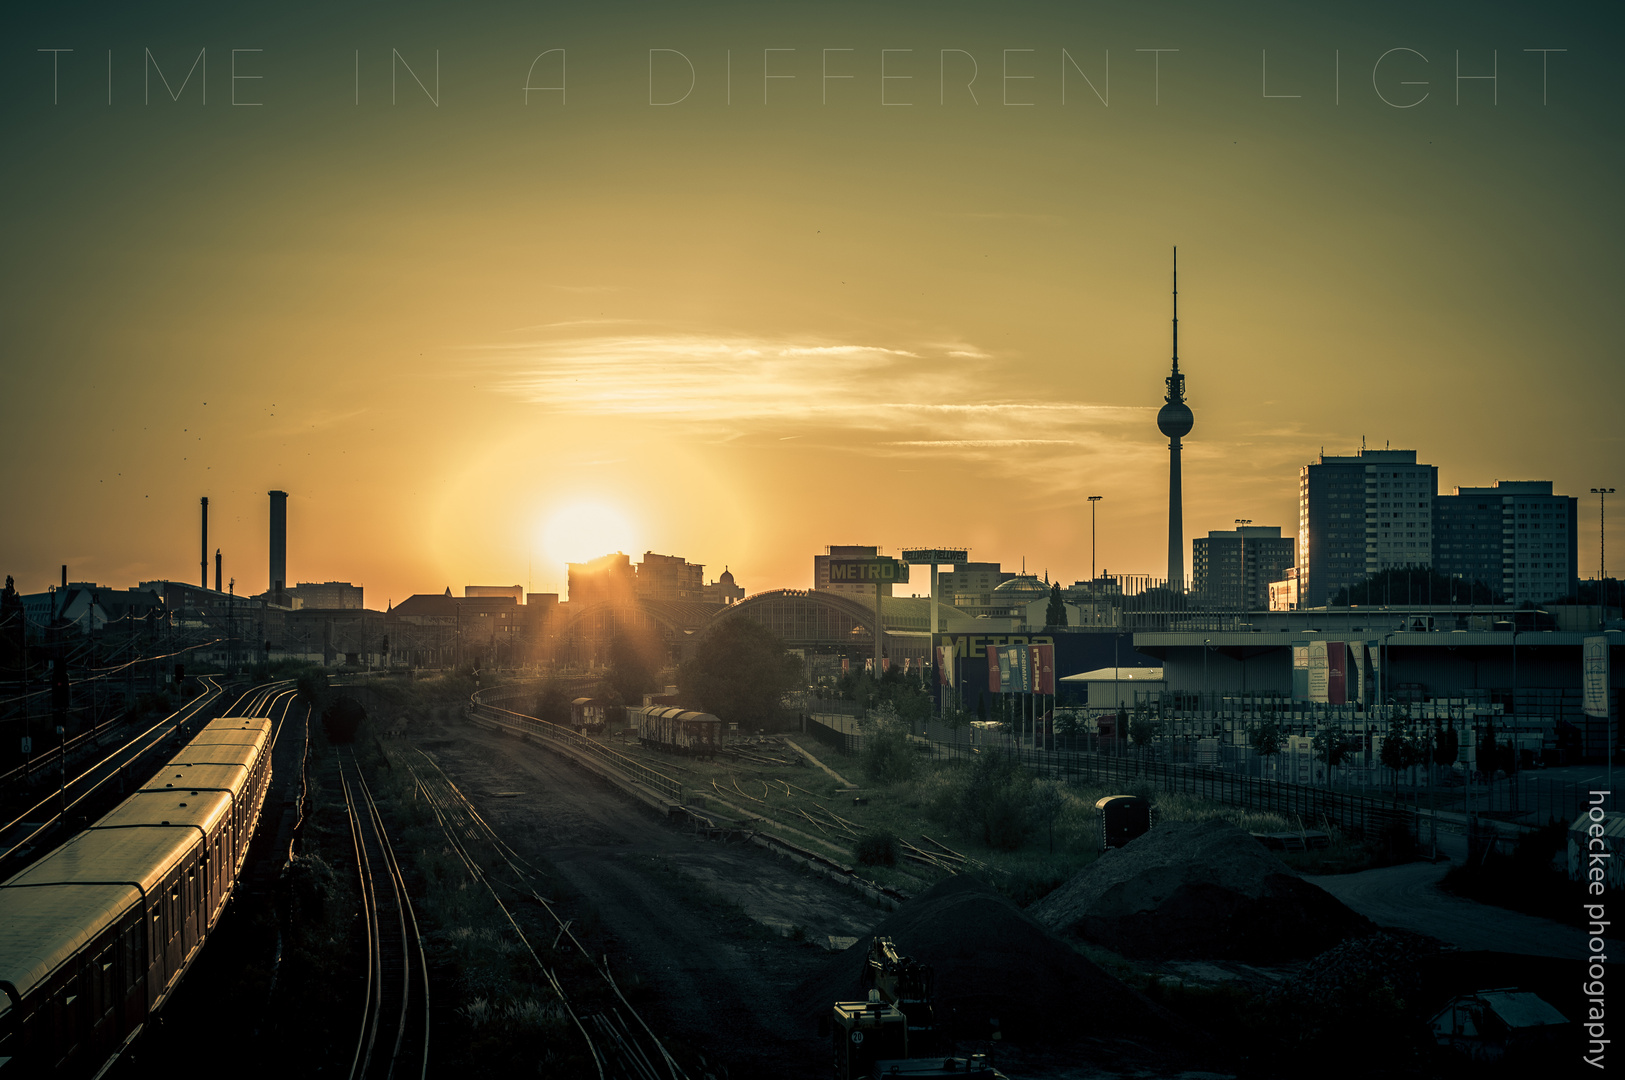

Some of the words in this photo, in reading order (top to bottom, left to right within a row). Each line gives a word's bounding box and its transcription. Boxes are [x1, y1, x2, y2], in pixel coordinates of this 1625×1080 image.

[934, 551, 966, 560] HELLWEG
[831, 564, 894, 579] METRO
[854, 1033, 862, 1041] 20
